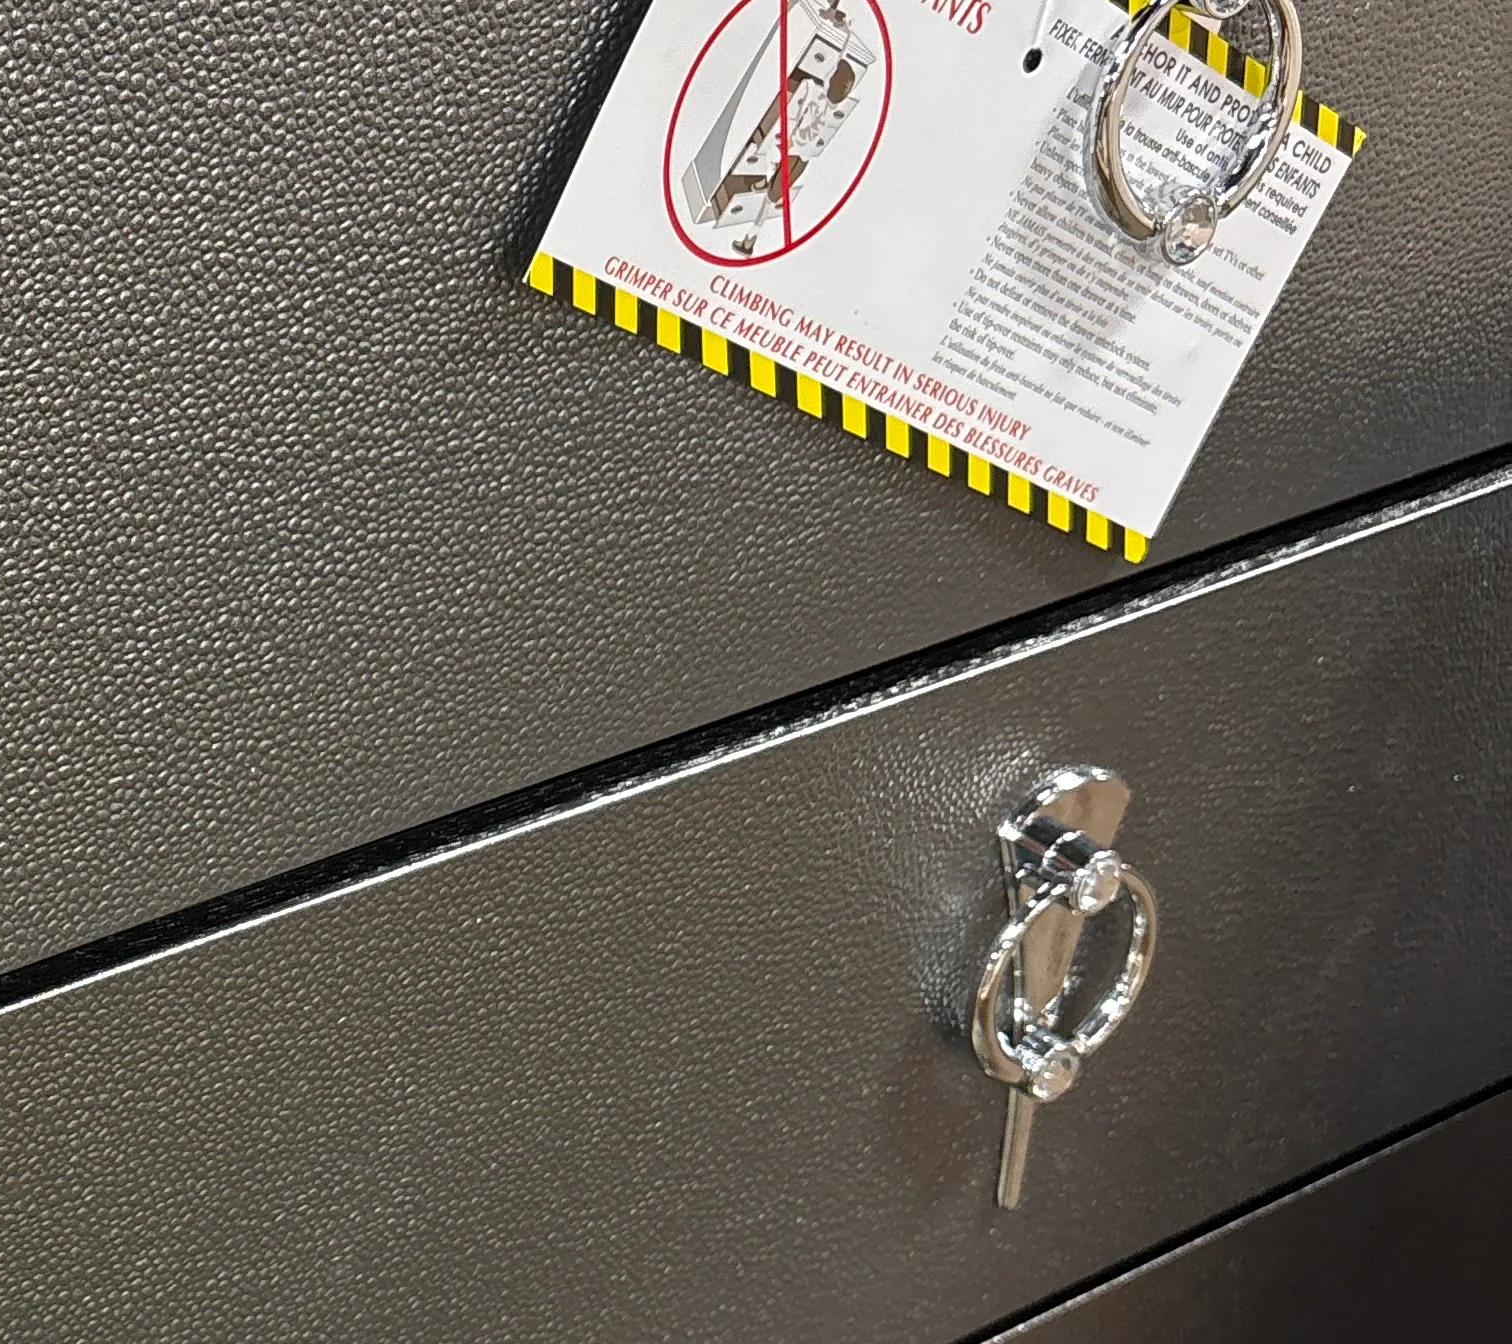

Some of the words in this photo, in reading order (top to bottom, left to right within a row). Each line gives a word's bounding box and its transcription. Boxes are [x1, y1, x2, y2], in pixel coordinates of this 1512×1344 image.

[1122, 120, 1136, 137] la
[1131, 126, 1163, 154] trousse
[1159, 146, 1211, 184] anti-bascule
[1138, 76, 1164, 100] AU
[1155, 85, 1186, 116] MUR
[1179, 100, 1214, 133] POUR
[1273, 160, 1321, 200] ENFANTS
[1173, 62, 1193, 85] IT
[1186, 73, 1222, 104] AND
[1218, 92, 1261, 131] PROT
[1291, 138, 1332, 174] CHILD
[1174, 126, 1195, 149] Use
[1193, 142, 1209, 157] of
[1263, 185, 1309, 218] required
[603, 255, 674, 302] GRIMPER
[670, 287, 709, 318] SUR
[708, 305, 736, 330] CE
[731, 317, 805, 362] MEUBLE
[801, 349, 849, 382] PEUT
[844, 370, 933, 424] ENTRAINER
[930, 411, 965, 439] DES
[961, 426, 1043, 476] BLESSURES
[1041, 464, 1100, 503] GRAVES
[708, 273, 795, 328] CLIMBING
[792, 315, 836, 346] MAY
[832, 333, 895, 375] RESULT
[891, 361, 915, 385] IN
[911, 372, 979, 417] SERIOUS
[976, 403, 1032, 441] INJURY
